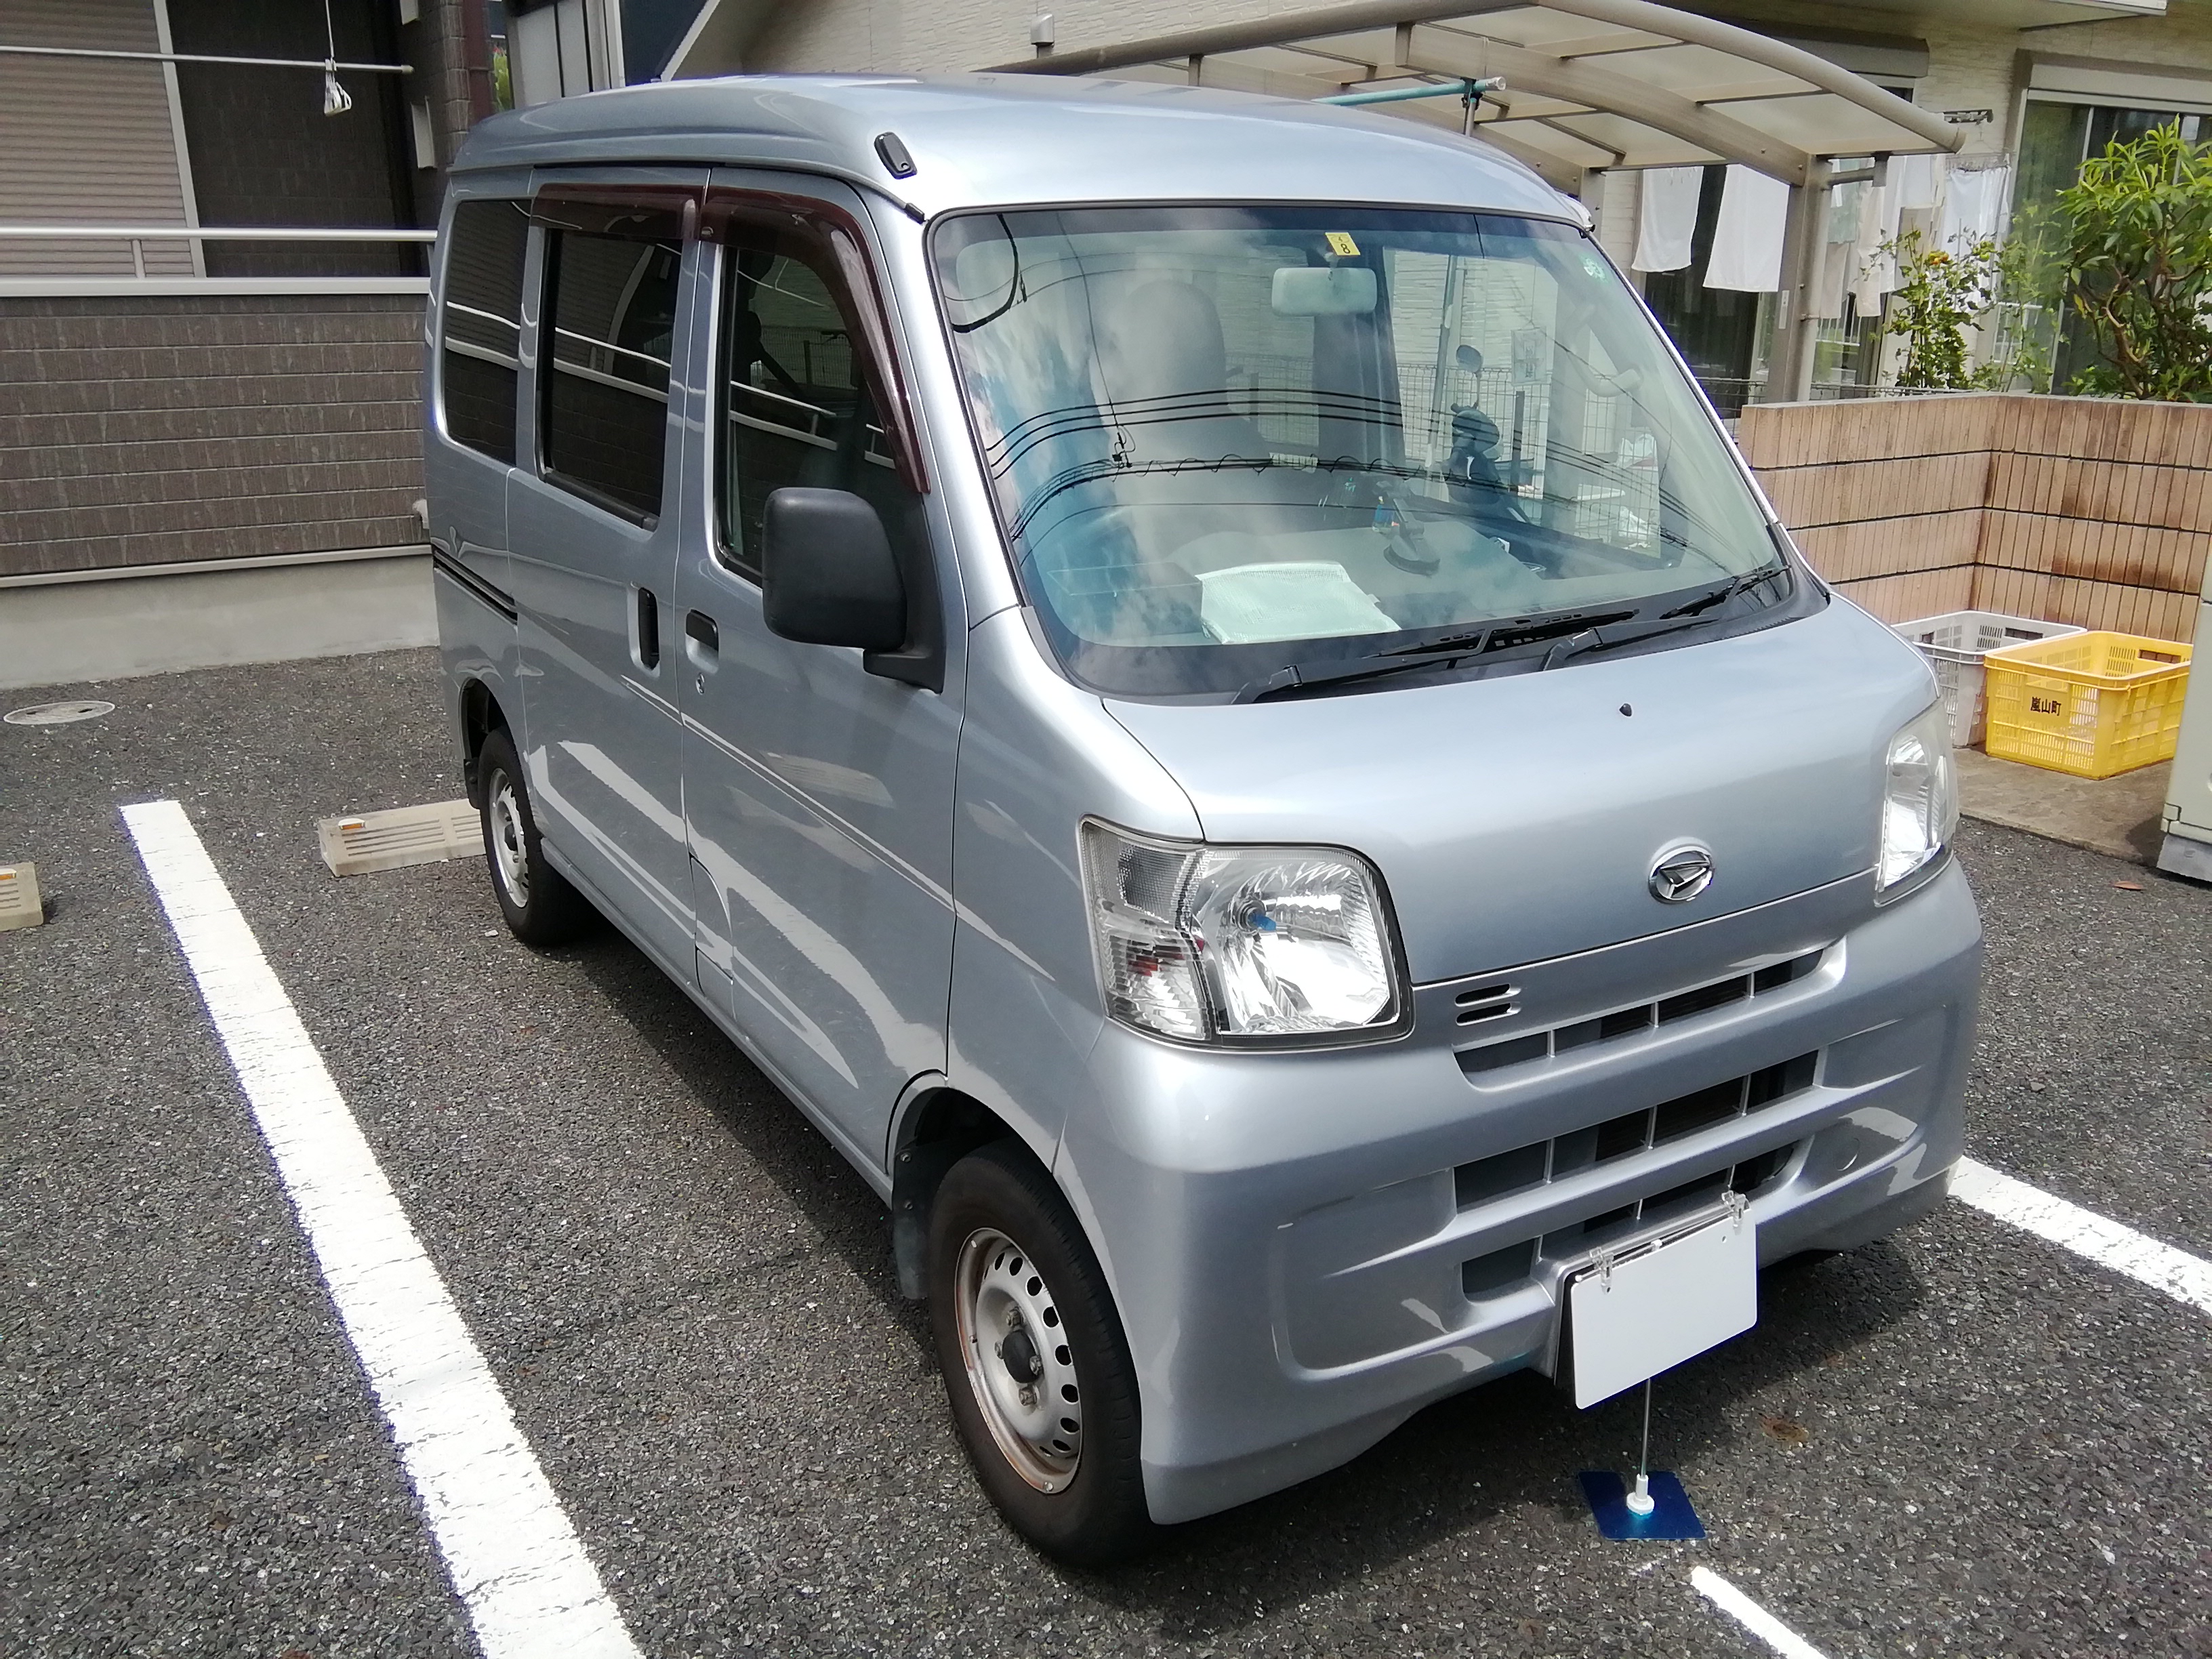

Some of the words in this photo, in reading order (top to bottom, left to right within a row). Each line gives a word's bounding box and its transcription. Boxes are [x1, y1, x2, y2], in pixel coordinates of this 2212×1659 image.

[1340, 243, 1351, 254] 8
[2030, 696, 2062, 716] 嵐山町
